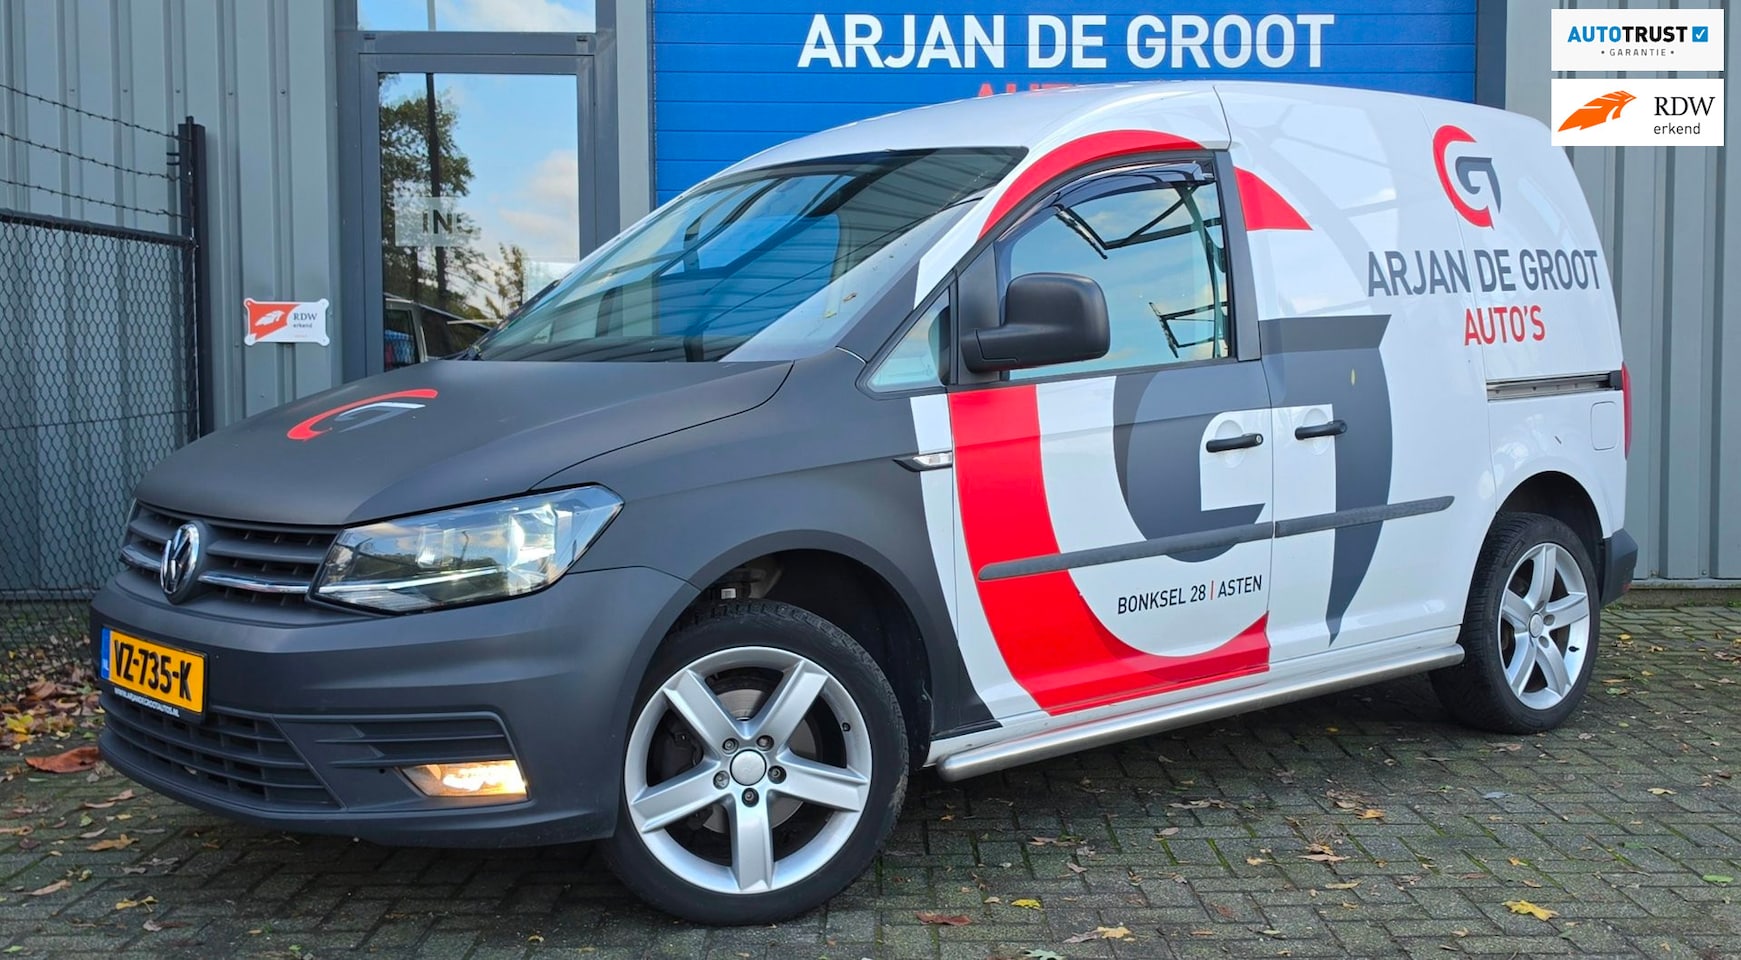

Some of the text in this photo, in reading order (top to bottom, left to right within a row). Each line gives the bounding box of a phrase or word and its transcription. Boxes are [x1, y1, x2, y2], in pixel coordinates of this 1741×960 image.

[797, 14, 1335, 69] ARJAN DE GROOT
[1367, 249, 1600, 298] ARJAN DE GROOT
[293, 312, 318, 321] RDW
[1464, 304, 1546, 347] AUTO'S
[1117, 587, 1187, 615] BONKSEL
[1190, 584, 1206, 604] 28
[1217, 574, 1263, 598] ASTEN
[114, 638, 193, 702] VZ-735-K
